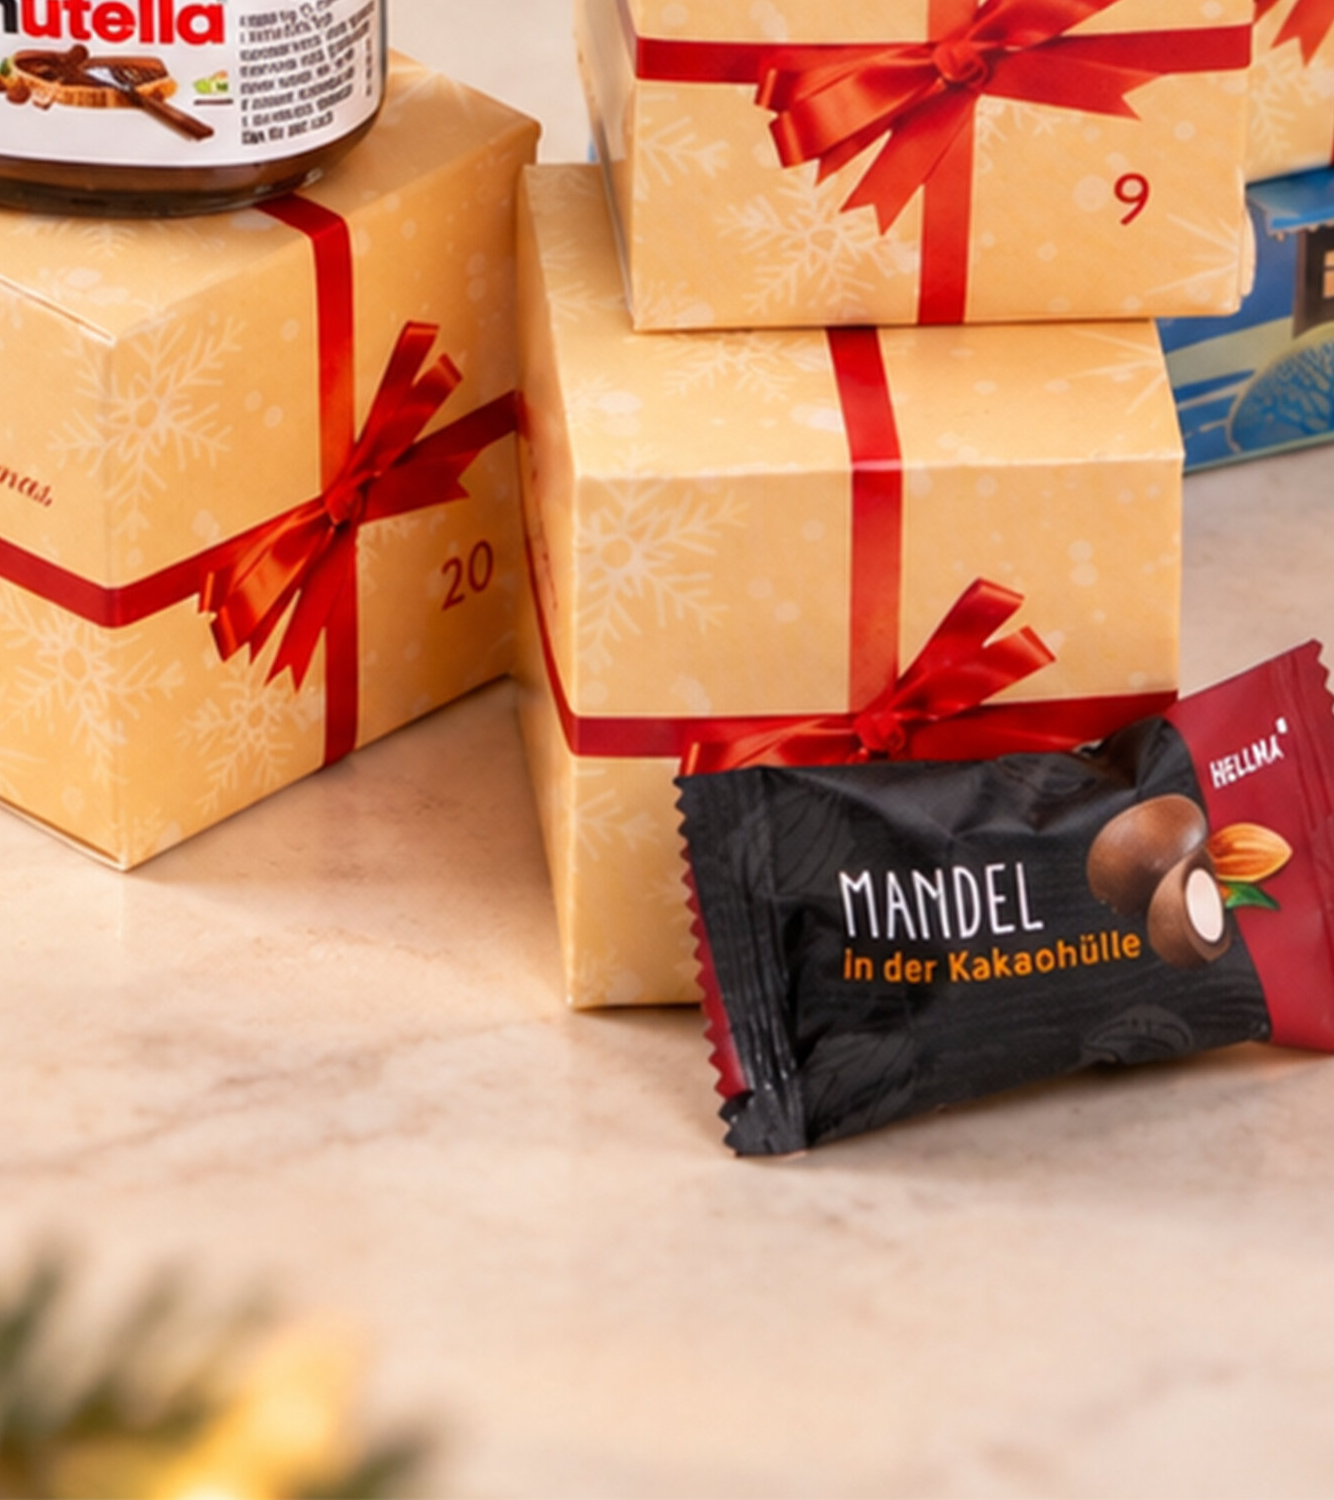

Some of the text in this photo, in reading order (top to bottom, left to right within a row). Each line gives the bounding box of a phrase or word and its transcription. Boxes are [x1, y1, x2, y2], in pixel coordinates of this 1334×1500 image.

[1113, 172, 1151, 226] 9
[439, 539, 495, 612] 20
[838, 861, 1045, 942] MANDEL
[842, 930, 1142, 983] in der Kakaohülle
